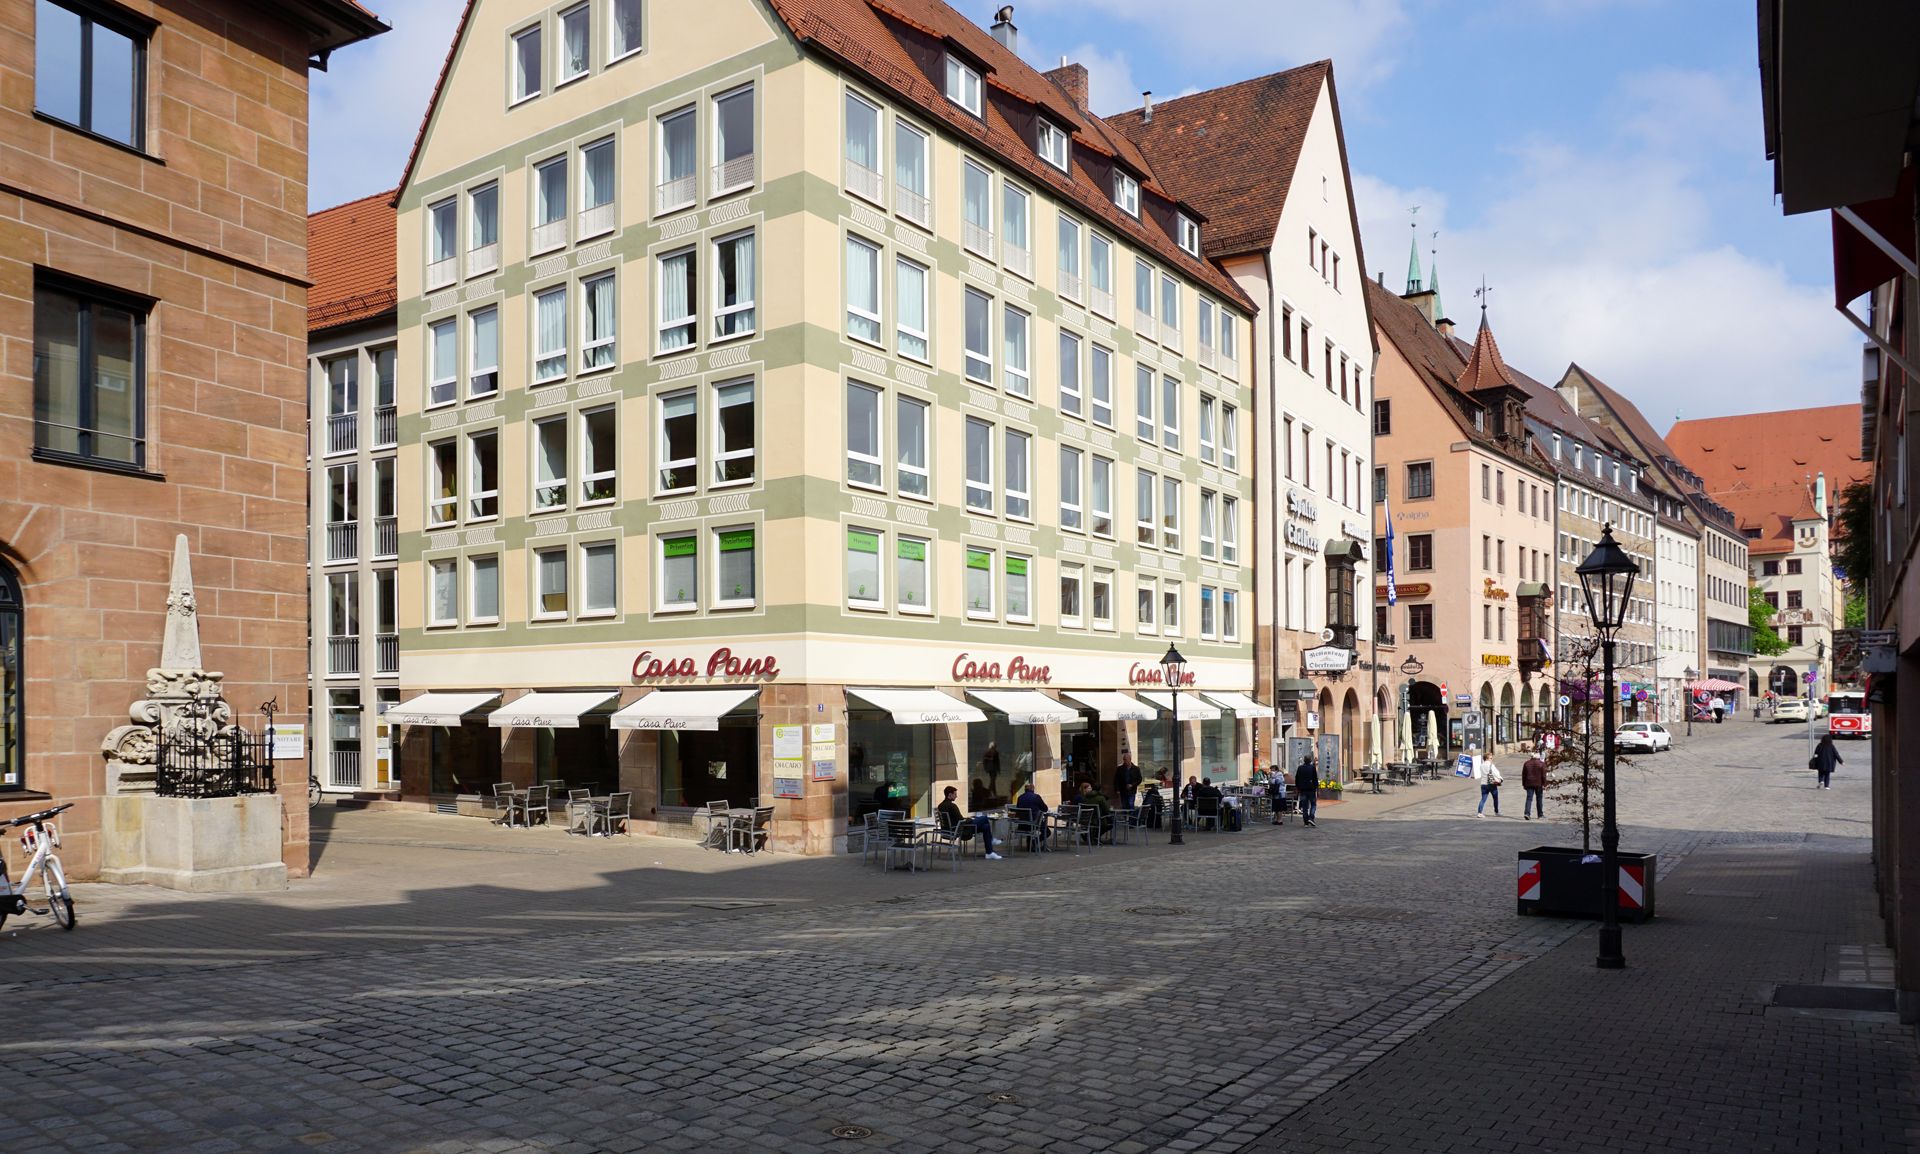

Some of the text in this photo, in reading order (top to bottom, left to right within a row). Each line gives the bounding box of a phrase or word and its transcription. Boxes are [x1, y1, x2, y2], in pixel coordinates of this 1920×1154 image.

[632, 647, 780, 678] Casa Pane
[952, 652, 1052, 683] Casa Pane
[1129, 661, 1163, 685] Casa
[402, 714, 438, 724] Casa Pane
[511, 716, 552, 726] Casa Pane
[920, 712, 962, 722] Casa Pane
[1028, 714, 1045, 723] Casa
[638, 718, 688, 728] Casa Pane
